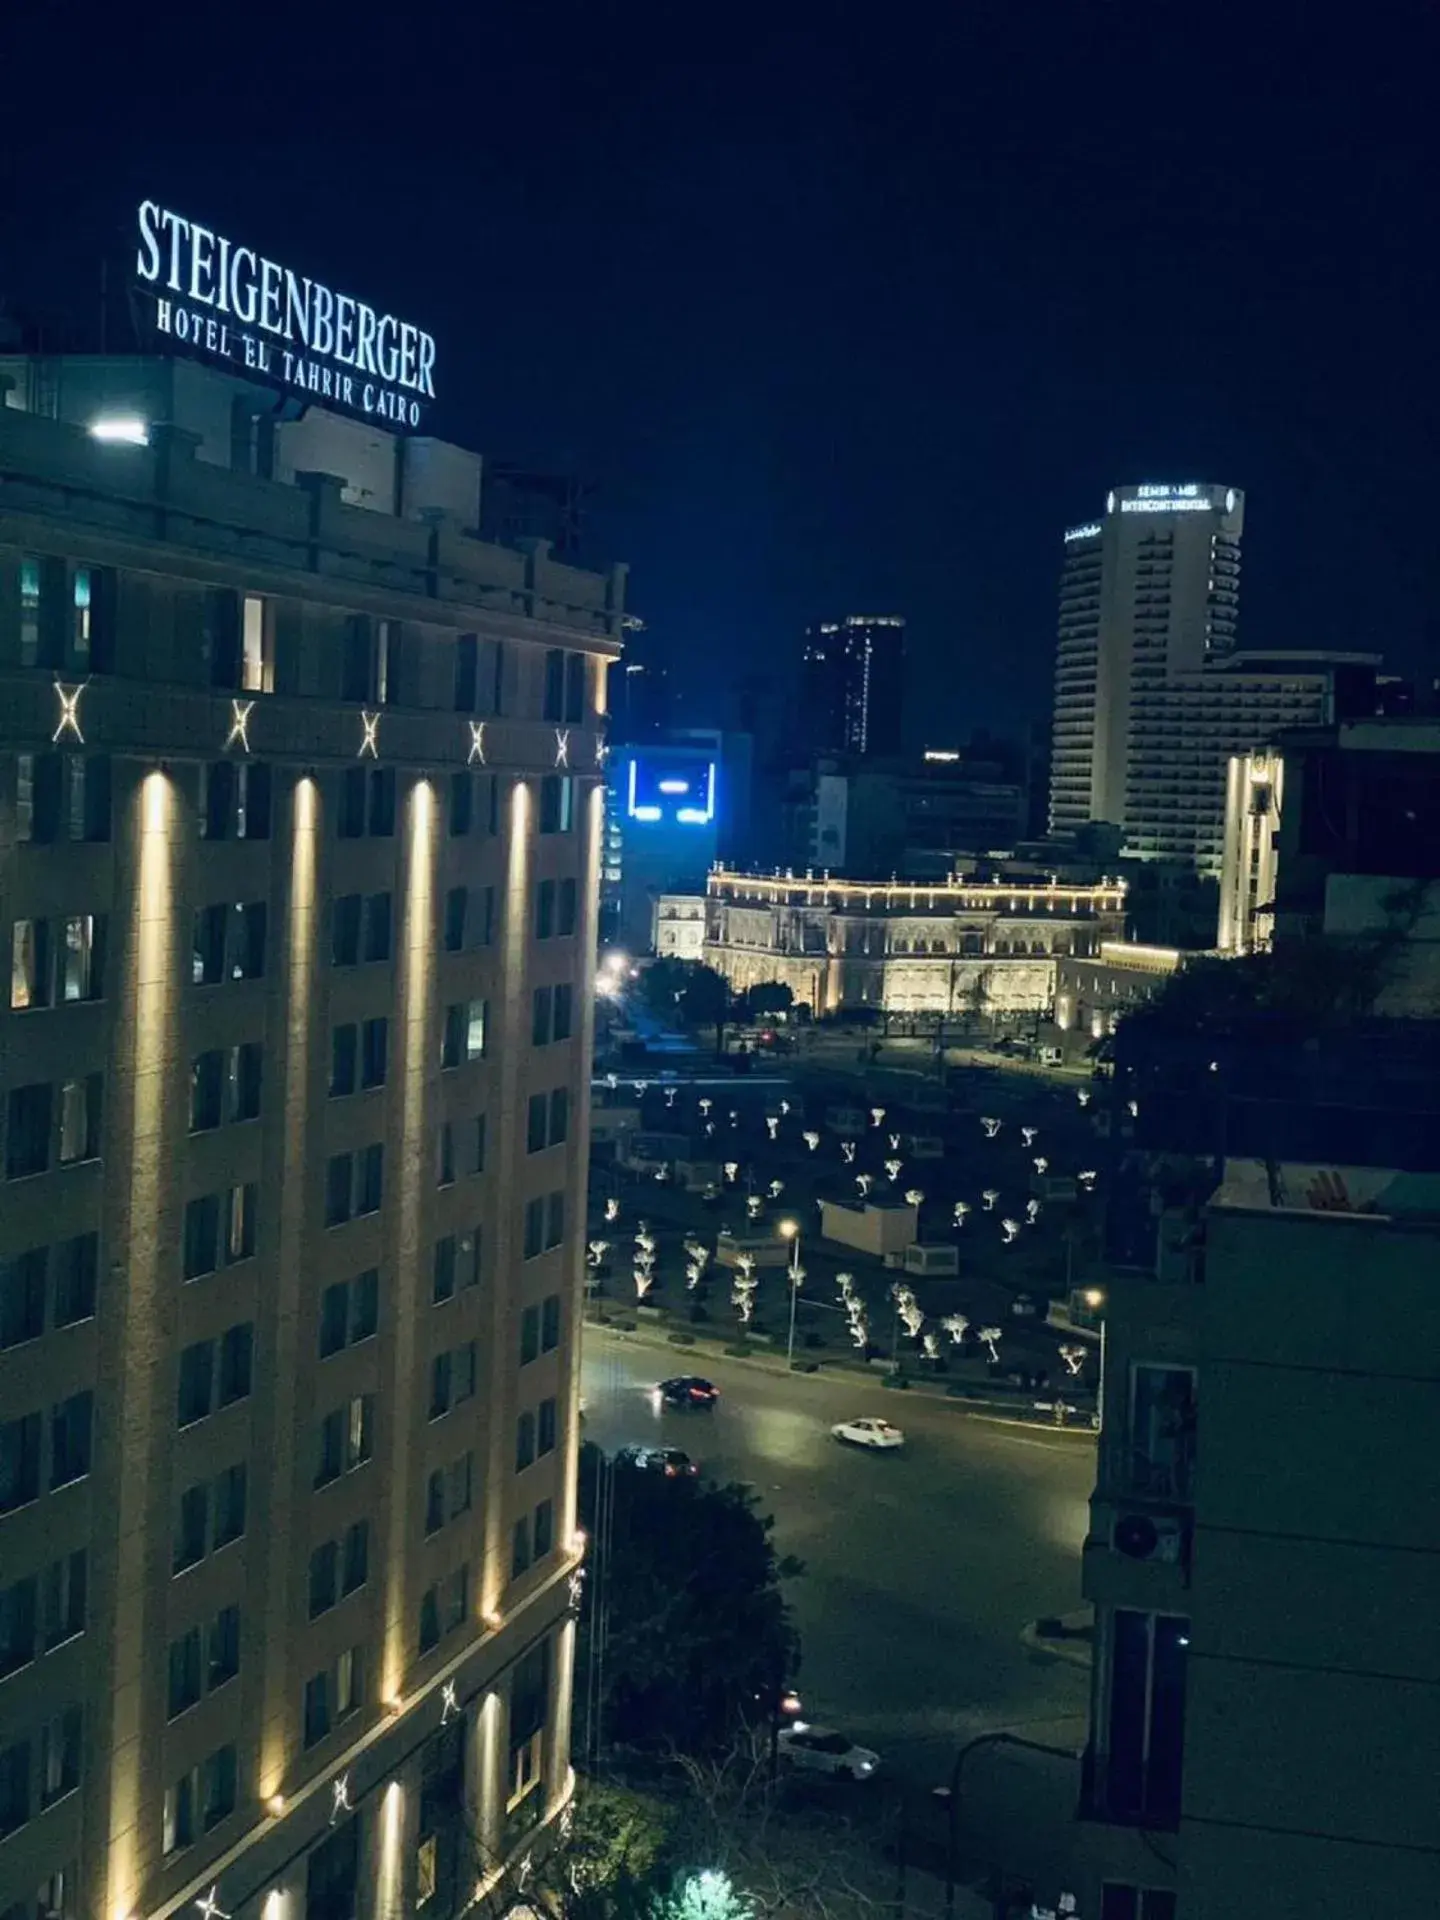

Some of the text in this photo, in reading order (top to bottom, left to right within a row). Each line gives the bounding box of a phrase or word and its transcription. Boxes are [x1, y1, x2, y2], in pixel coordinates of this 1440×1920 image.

[136, 198, 437, 400] STEIGENBERGER
[156, 297, 420, 428] HOTEL EL TAHRIR CAIRO
